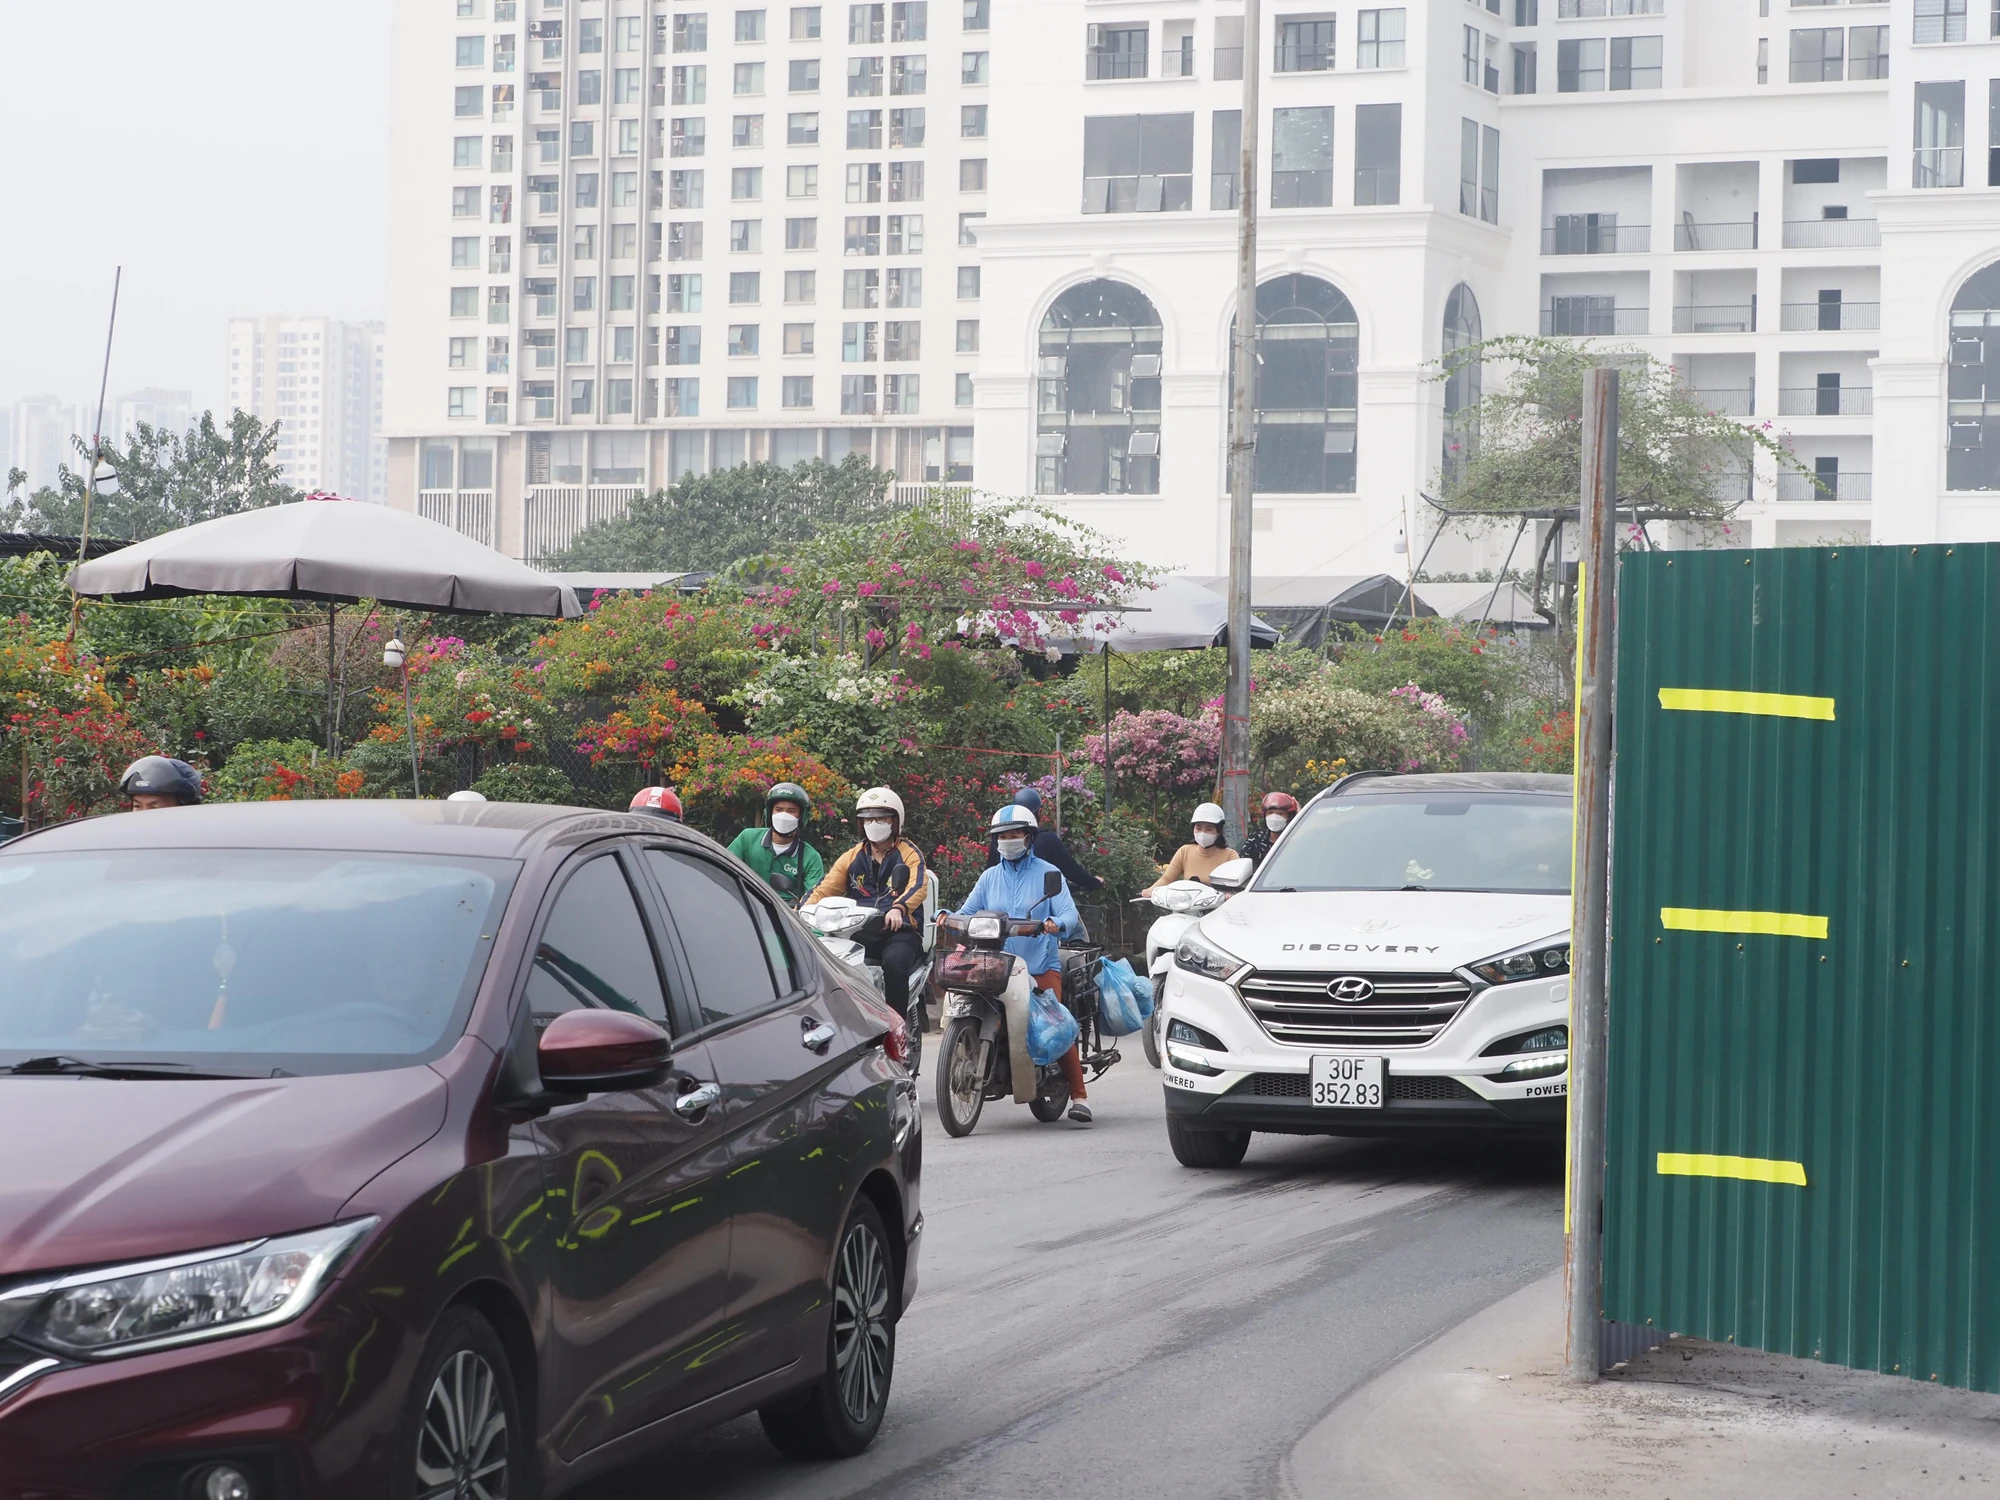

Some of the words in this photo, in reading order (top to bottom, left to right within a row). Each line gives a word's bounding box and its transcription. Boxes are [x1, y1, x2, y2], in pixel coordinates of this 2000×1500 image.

[783, 863, 798, 875] Gra
[1282, 943, 1440, 954] DISCOVERY
[1328, 1058, 1366, 1080] 30F
[1314, 1082, 1380, 1105] 352.83
[1526, 1084, 1567, 1097] POWER
